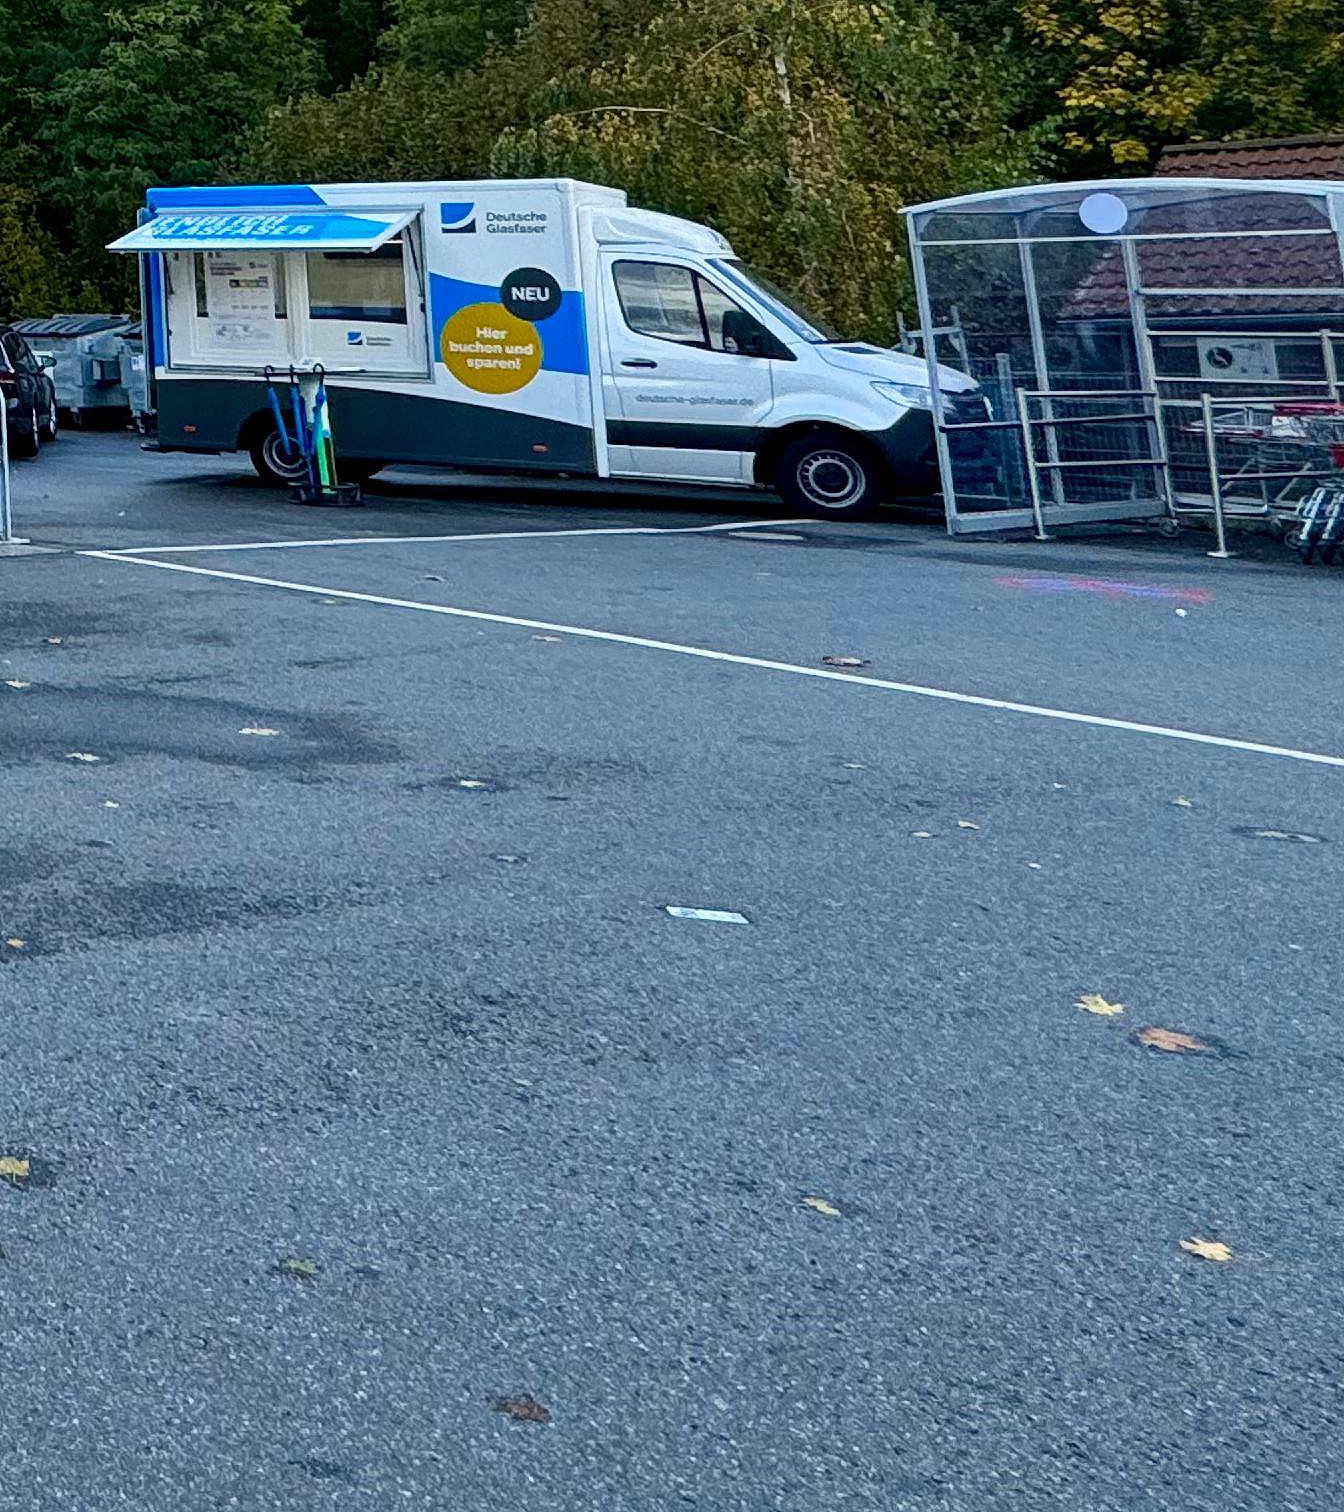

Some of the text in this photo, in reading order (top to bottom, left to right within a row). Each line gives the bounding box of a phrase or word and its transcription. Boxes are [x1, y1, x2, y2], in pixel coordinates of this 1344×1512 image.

[486, 211, 548, 223] Deutsche
[486, 223, 547, 234] Glasfaser
[511, 286, 551, 302] NEU
[476, 327, 509, 340] Hier
[448, 340, 535, 355] buchen und
[466, 357, 522, 370] sparen!
